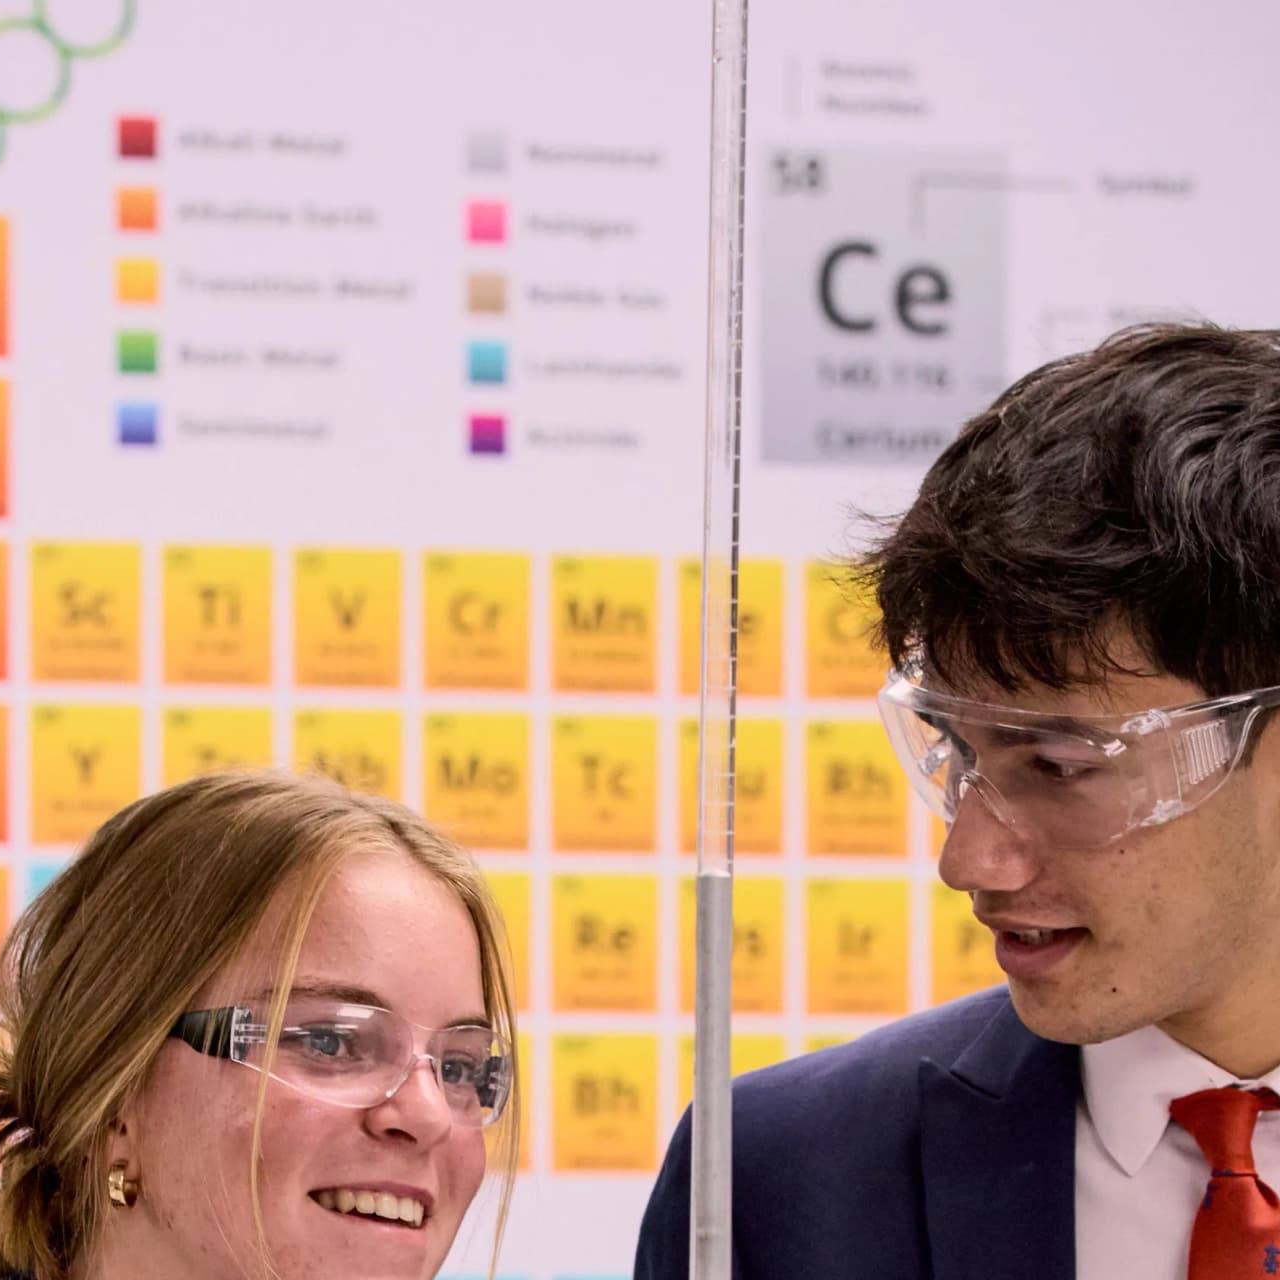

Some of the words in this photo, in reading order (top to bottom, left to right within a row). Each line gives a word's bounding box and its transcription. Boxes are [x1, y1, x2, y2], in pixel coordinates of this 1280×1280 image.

[819, 240, 952, 335] Ce
[60, 585, 112, 630] Sc
[196, 585, 242, 629] Ti
[329, 587, 365, 629] V
[448, 596, 502, 636] Cr
[567, 597, 647, 637] Mn
[70, 746, 101, 785] Y
[439, 756, 518, 792] Mo
[581, 757, 626, 795] Tc
[575, 913, 636, 956] Re
[572, 1071, 638, 1113] Bh
